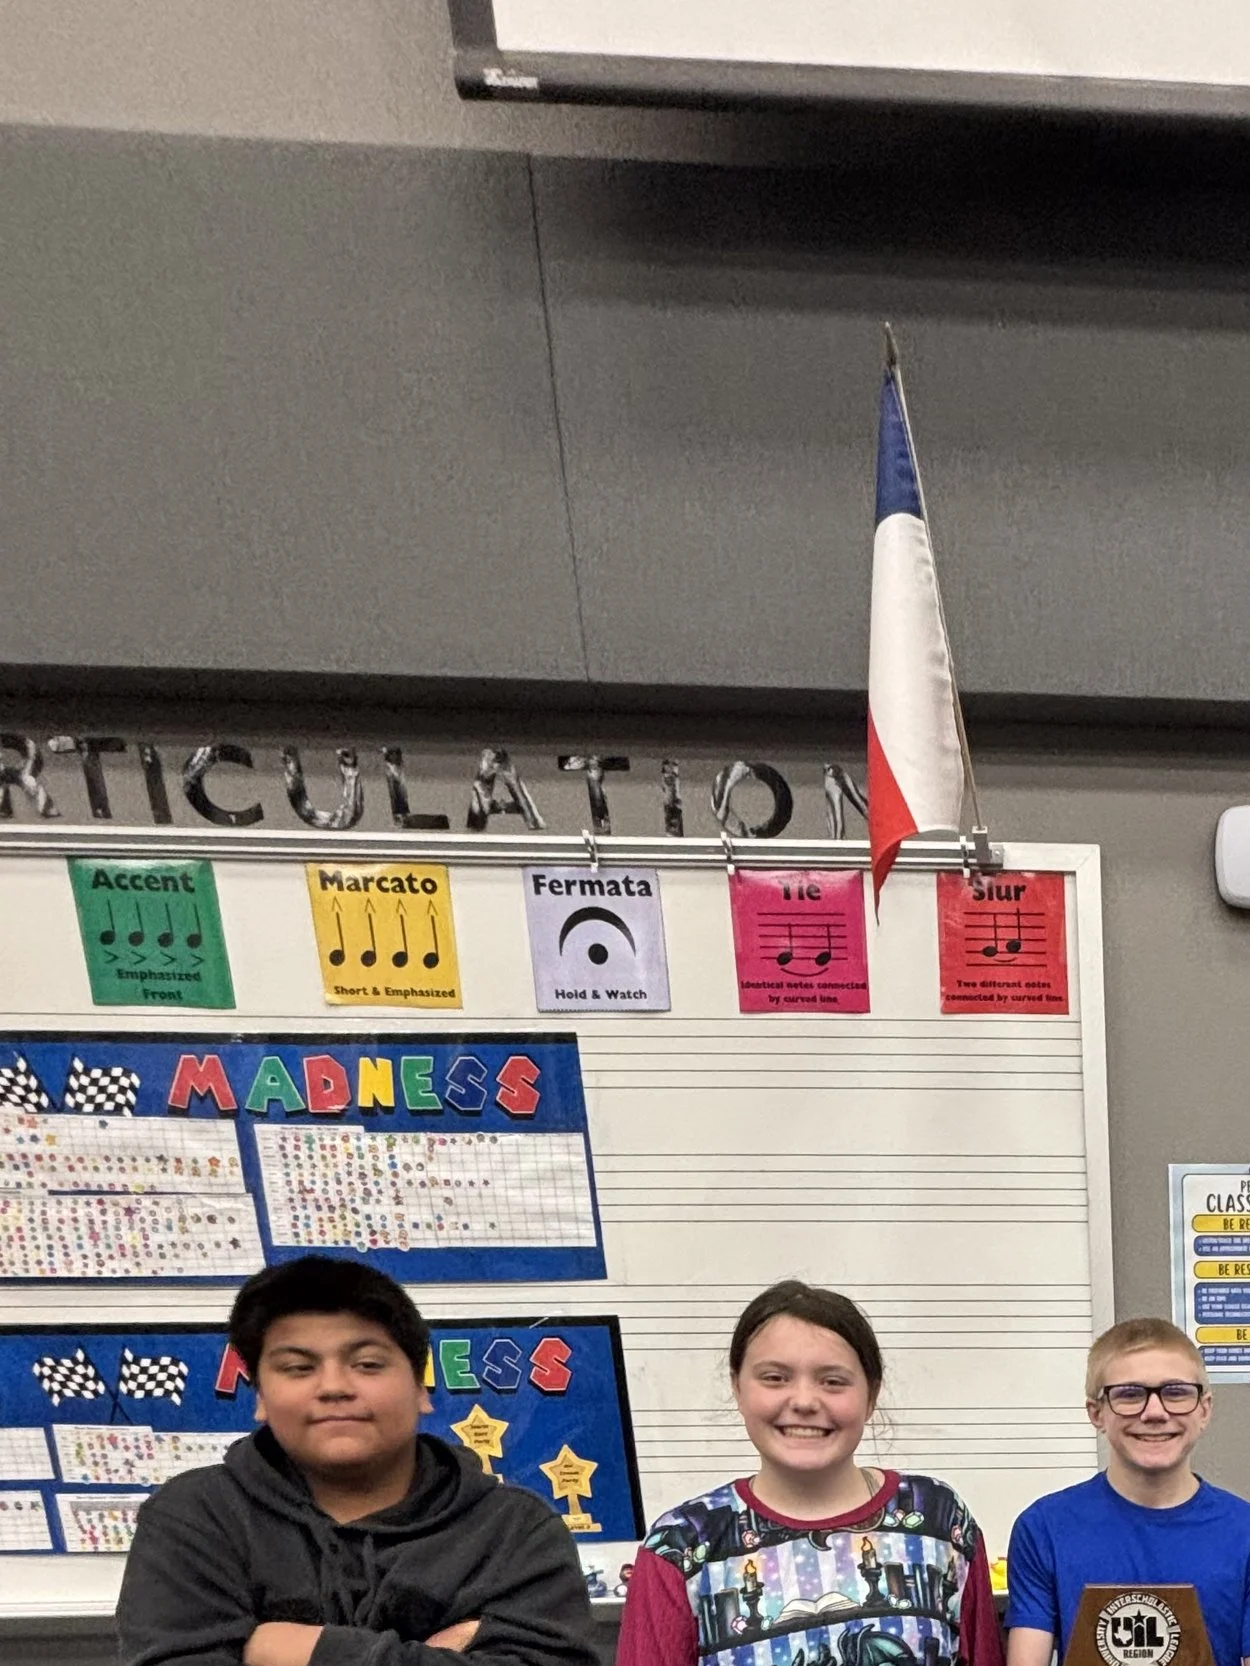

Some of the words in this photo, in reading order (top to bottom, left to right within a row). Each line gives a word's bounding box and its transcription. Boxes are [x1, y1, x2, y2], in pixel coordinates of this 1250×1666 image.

[92, 868, 195, 893] Accent
[318, 869, 438, 895] Marcato
[532, 874, 653, 897] Fermata
[117, 969, 201, 981] Emphasized
[817, 982, 867, 990] connected
[956, 980, 977, 989] Two
[979, 980, 1022, 988] different
[1024, 981, 1051, 989] notes
[144, 989, 183, 1000] Front
[334, 986, 369, 996] Short
[372, 987, 381, 996] &
[385, 987, 456, 998] Emphasized
[555, 989, 587, 999] Hold
[592, 990, 601, 999] &
[605, 989, 647, 999] Watch
[768, 995, 780, 1004] by
[996, 994, 1008, 1003] by
[168, 1054, 541, 1114] MADNESS
[1223, 1218, 1235, 1231] BE
[1218, 1263, 1230, 1276] BE
[1236, 1329, 1247, 1341] BE
[1106, 1594, 1178, 1626] INTERSCHOLASTIC
[1123, 1648, 1154, 1658] REGION
